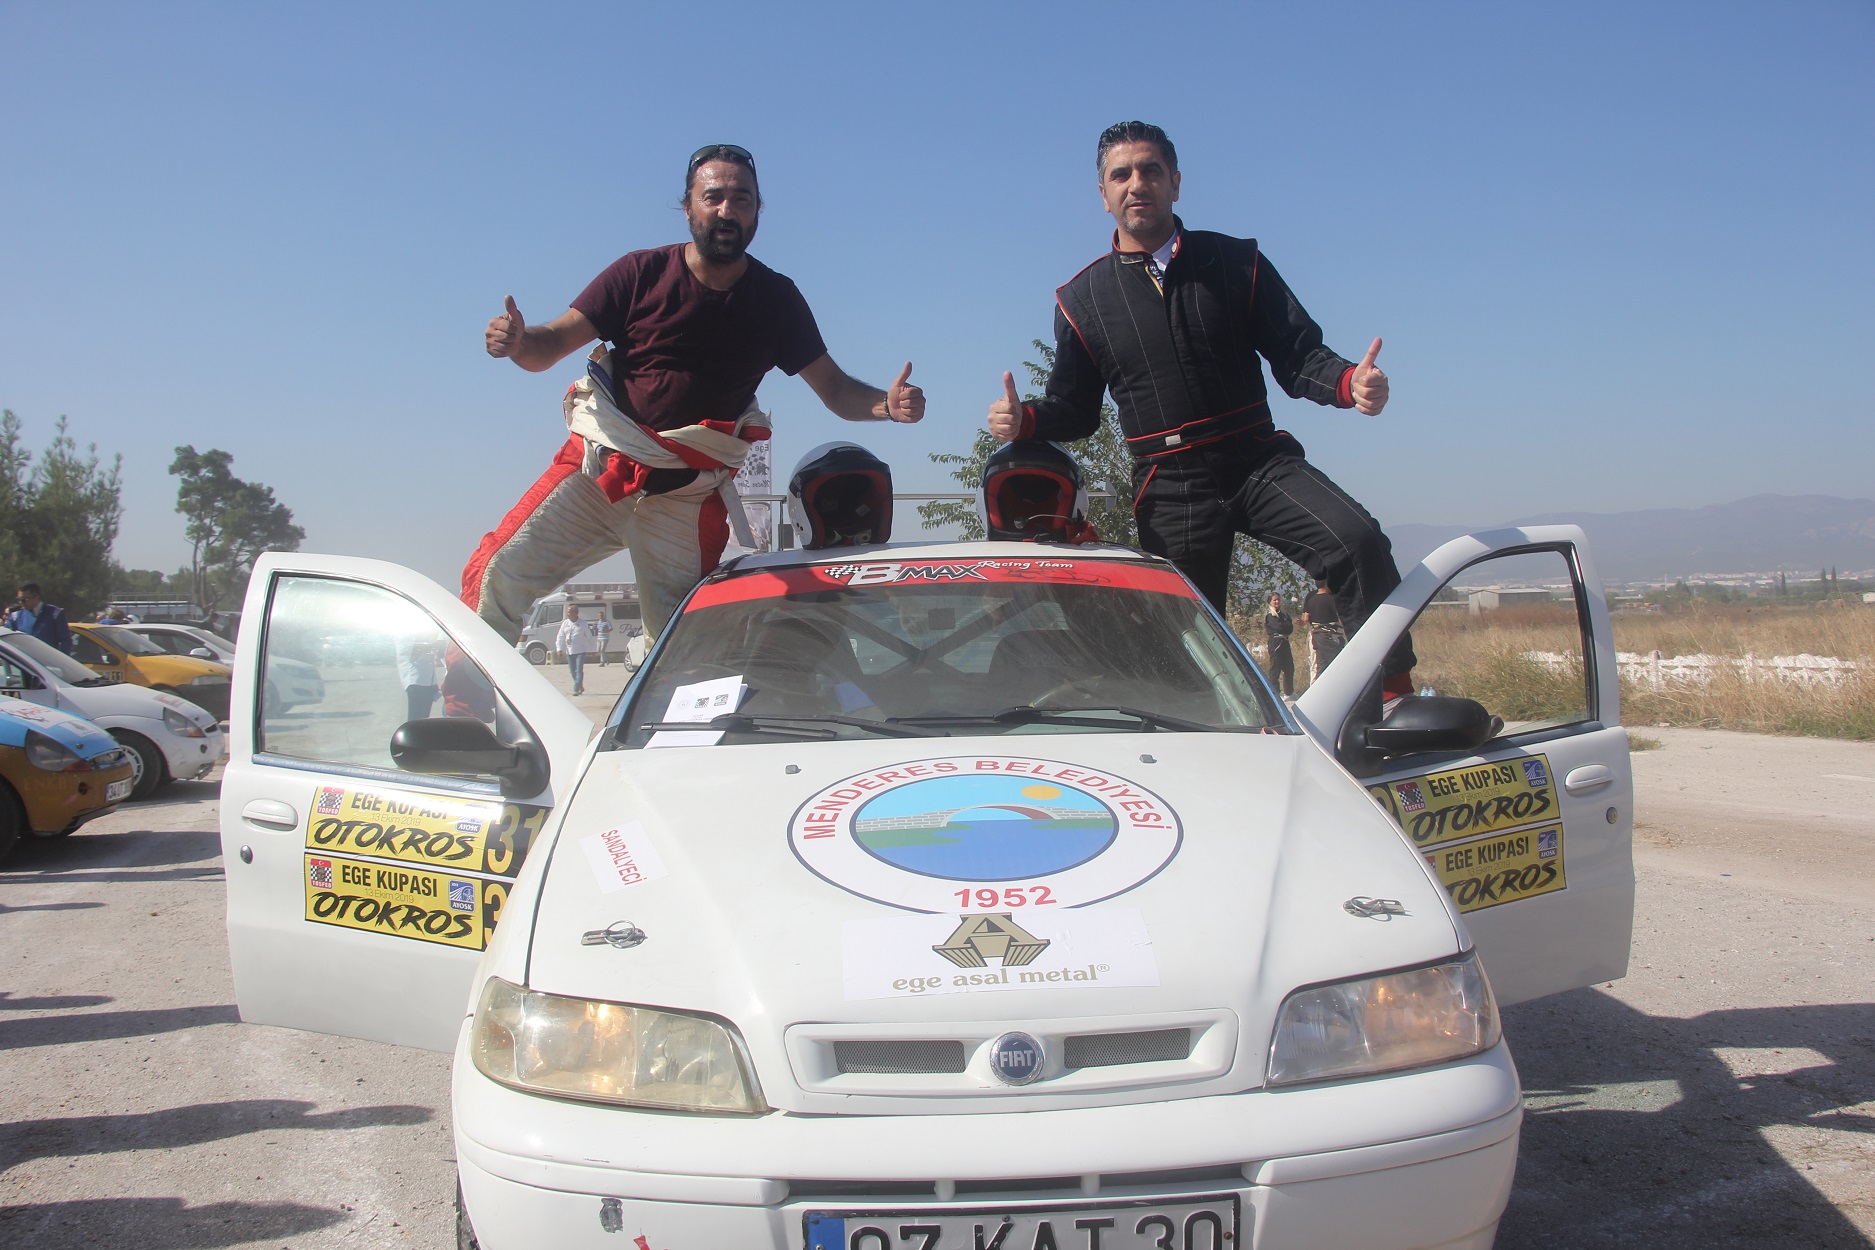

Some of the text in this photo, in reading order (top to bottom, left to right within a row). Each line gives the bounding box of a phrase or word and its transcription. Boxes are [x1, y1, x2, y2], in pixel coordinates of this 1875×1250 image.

[977, 560, 1074, 570] Racing Team
[1427, 765, 1518, 797] EGE KUPASI
[1483, 787, 1500, 797] 2019
[351, 791, 383, 812] EGE
[803, 760, 1173, 840] MENDERES BELEDİYESİ
[401, 816, 421, 827] 2019
[1408, 788, 1551, 842] OTOKROS
[312, 817, 479, 860] OTOKROS
[487, 804, 546, 874] 31
[1445, 836, 1529, 872] EGE KUPASI
[1494, 860, 1511, 871] 2019
[342, 865, 437, 897] EGE KUPASI
[364, 888, 415, 903] 13 Ekim 2019
[953, 885, 1057, 908] 1952
[310, 891, 476, 938] OTOKROS
[892, 975, 943, 993] ege
[952, 968, 1010, 987] asal
[999, 1049, 1034, 1068] FIAT
